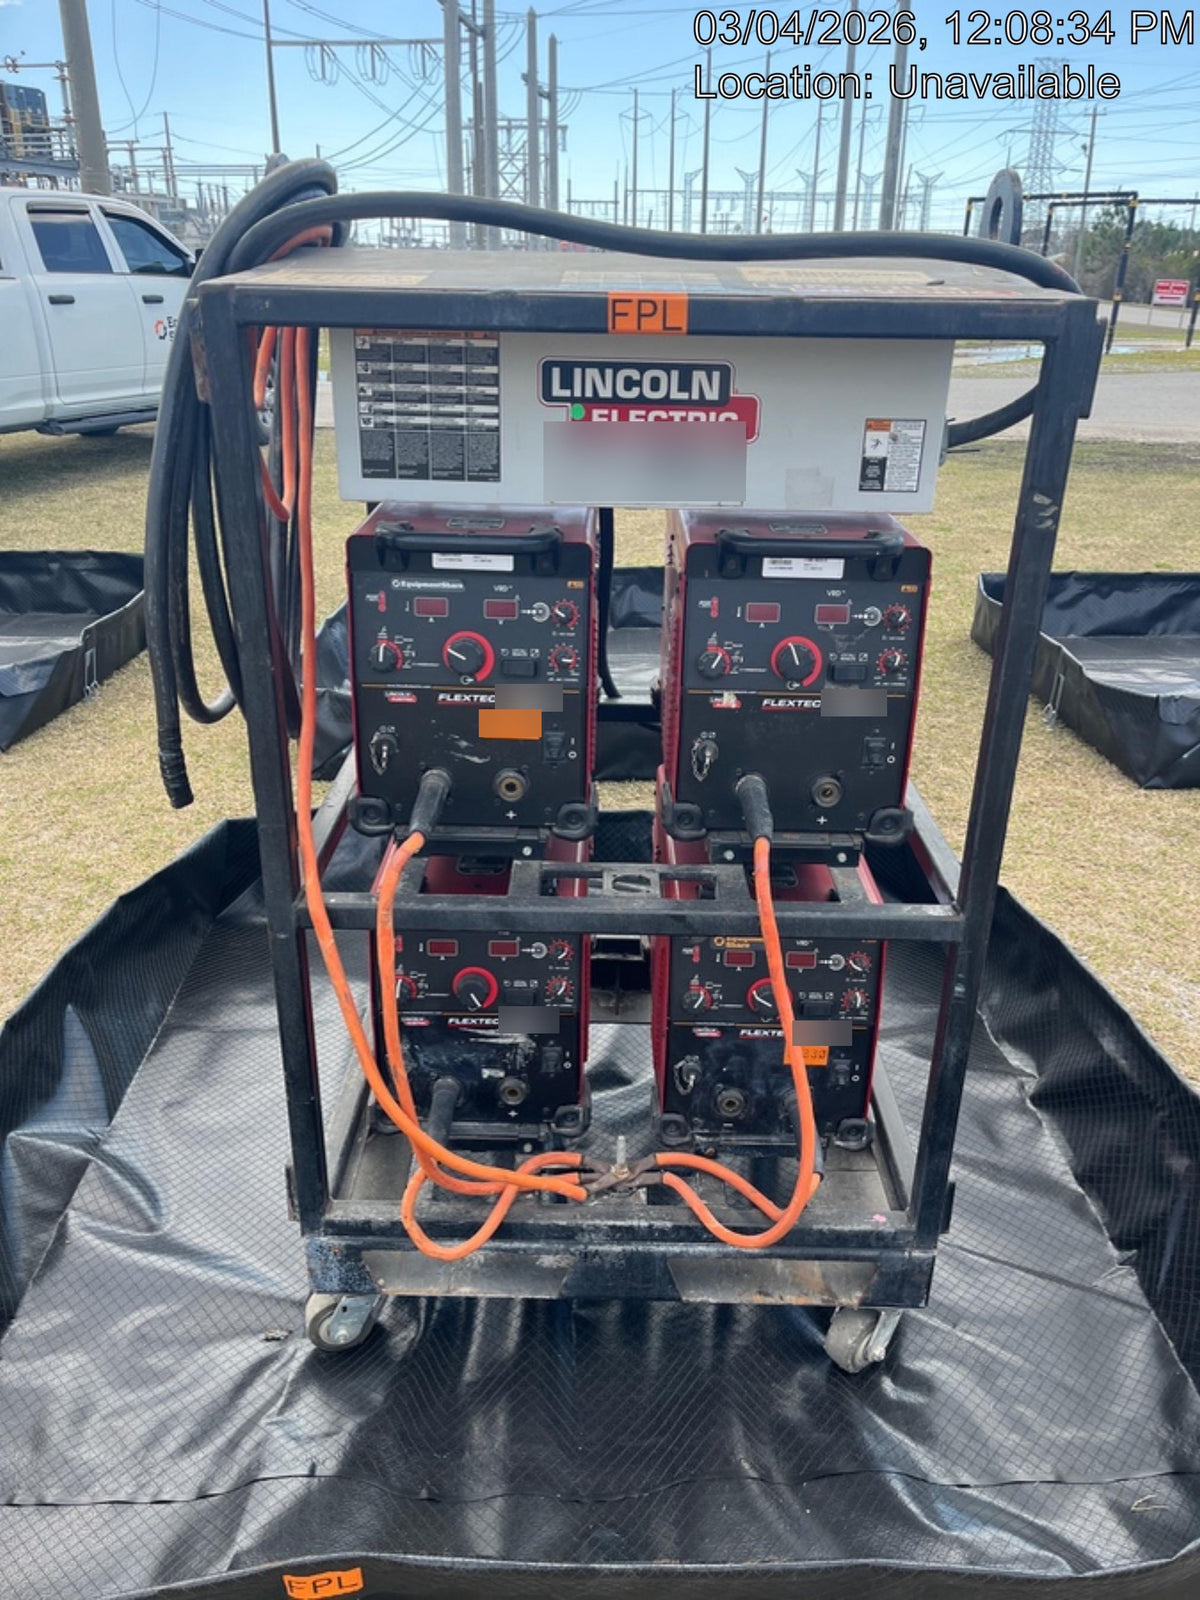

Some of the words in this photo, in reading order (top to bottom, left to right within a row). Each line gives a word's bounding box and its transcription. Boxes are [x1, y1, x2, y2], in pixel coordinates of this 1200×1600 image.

[611, 298, 683, 331] FPL
[551, 367, 720, 401] LINCOLN
[288, 1576, 359, 1594] FPL
